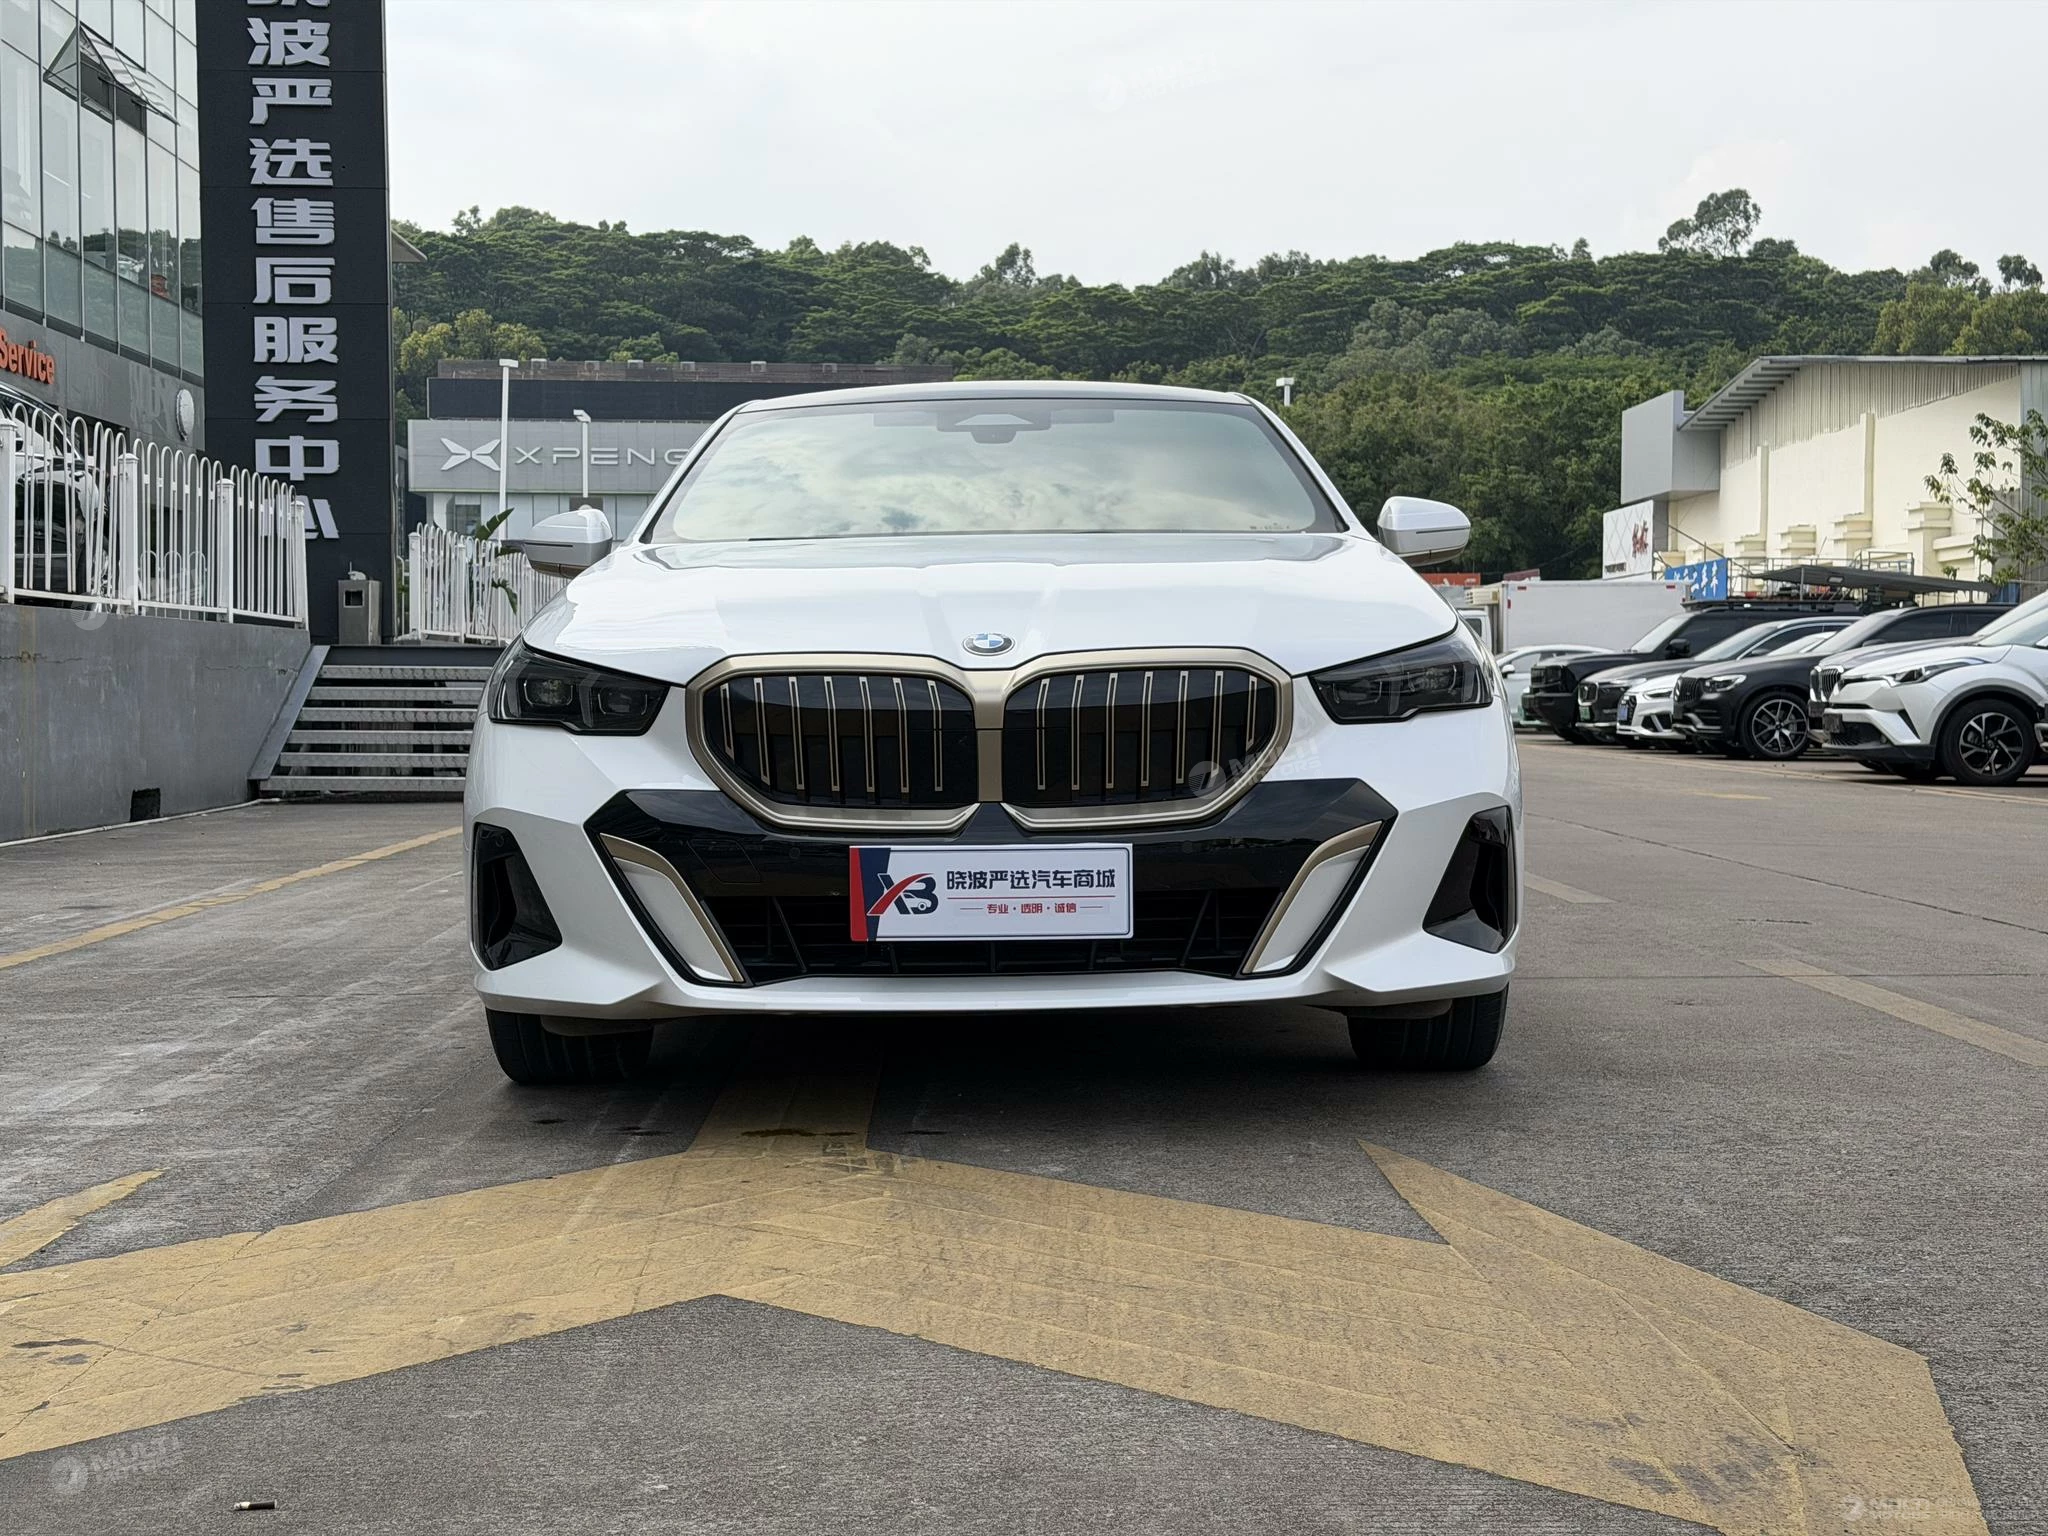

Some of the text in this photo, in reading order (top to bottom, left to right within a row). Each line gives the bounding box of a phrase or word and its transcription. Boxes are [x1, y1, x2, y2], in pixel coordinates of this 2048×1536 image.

[247, 0, 339, 539] 波严选售后服务中心
[0, 325, 55, 385] Service
[946, 869, 1116, 890] 晓波严选汽车商城
